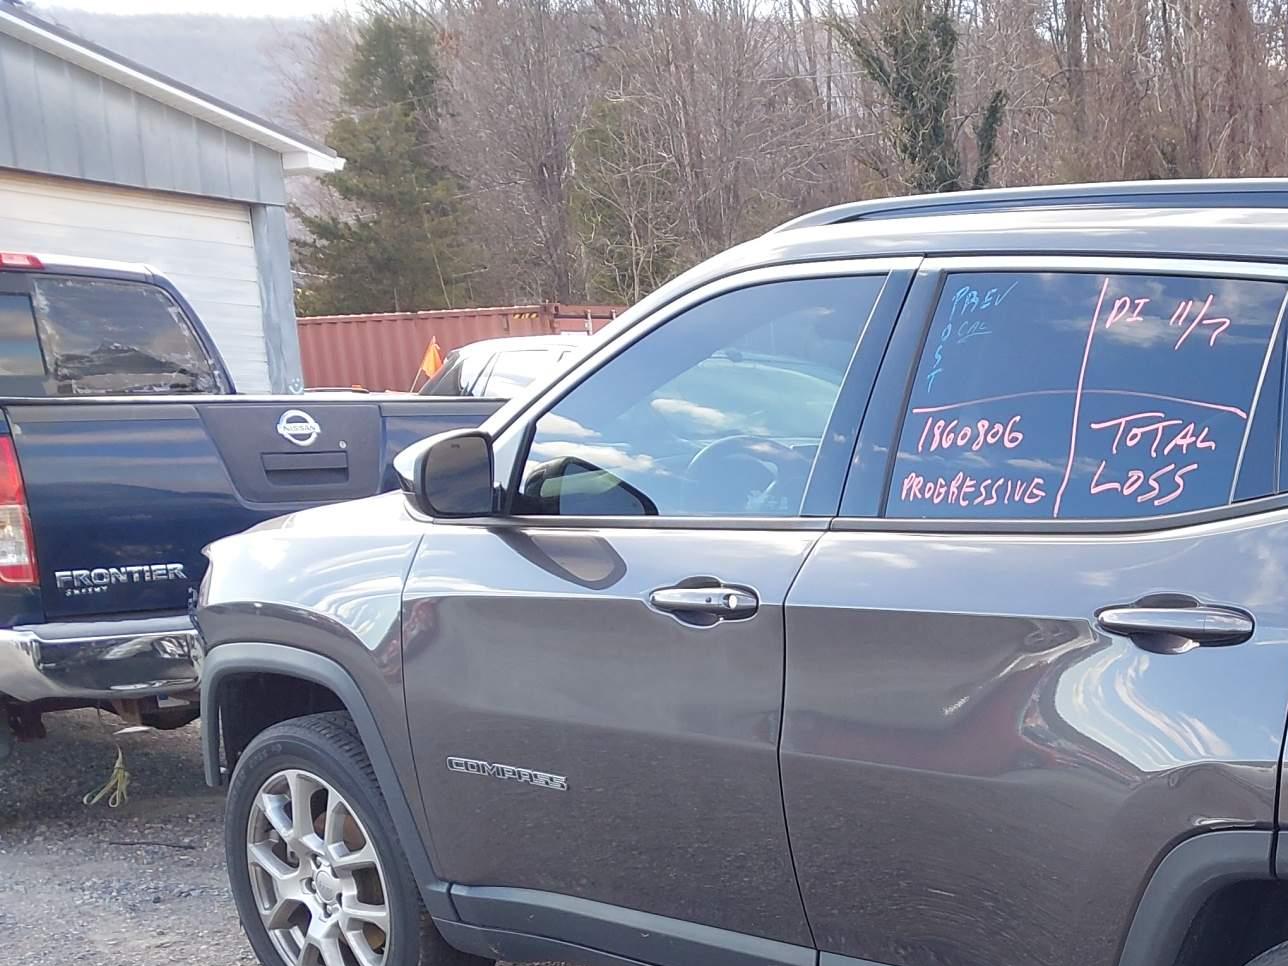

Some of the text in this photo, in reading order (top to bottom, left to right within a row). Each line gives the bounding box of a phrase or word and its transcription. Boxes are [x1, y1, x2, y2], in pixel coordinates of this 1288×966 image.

[917, 415, 1024, 453] 1860806
[1090, 411, 1216, 458] TOTAL
[901, 471, 1047, 507] PROGRESSIVE
[1090, 459, 1199, 506] LOSS
[54, 562, 188, 588] FRONTIER
[446, 756, 569, 791] COMPASS
